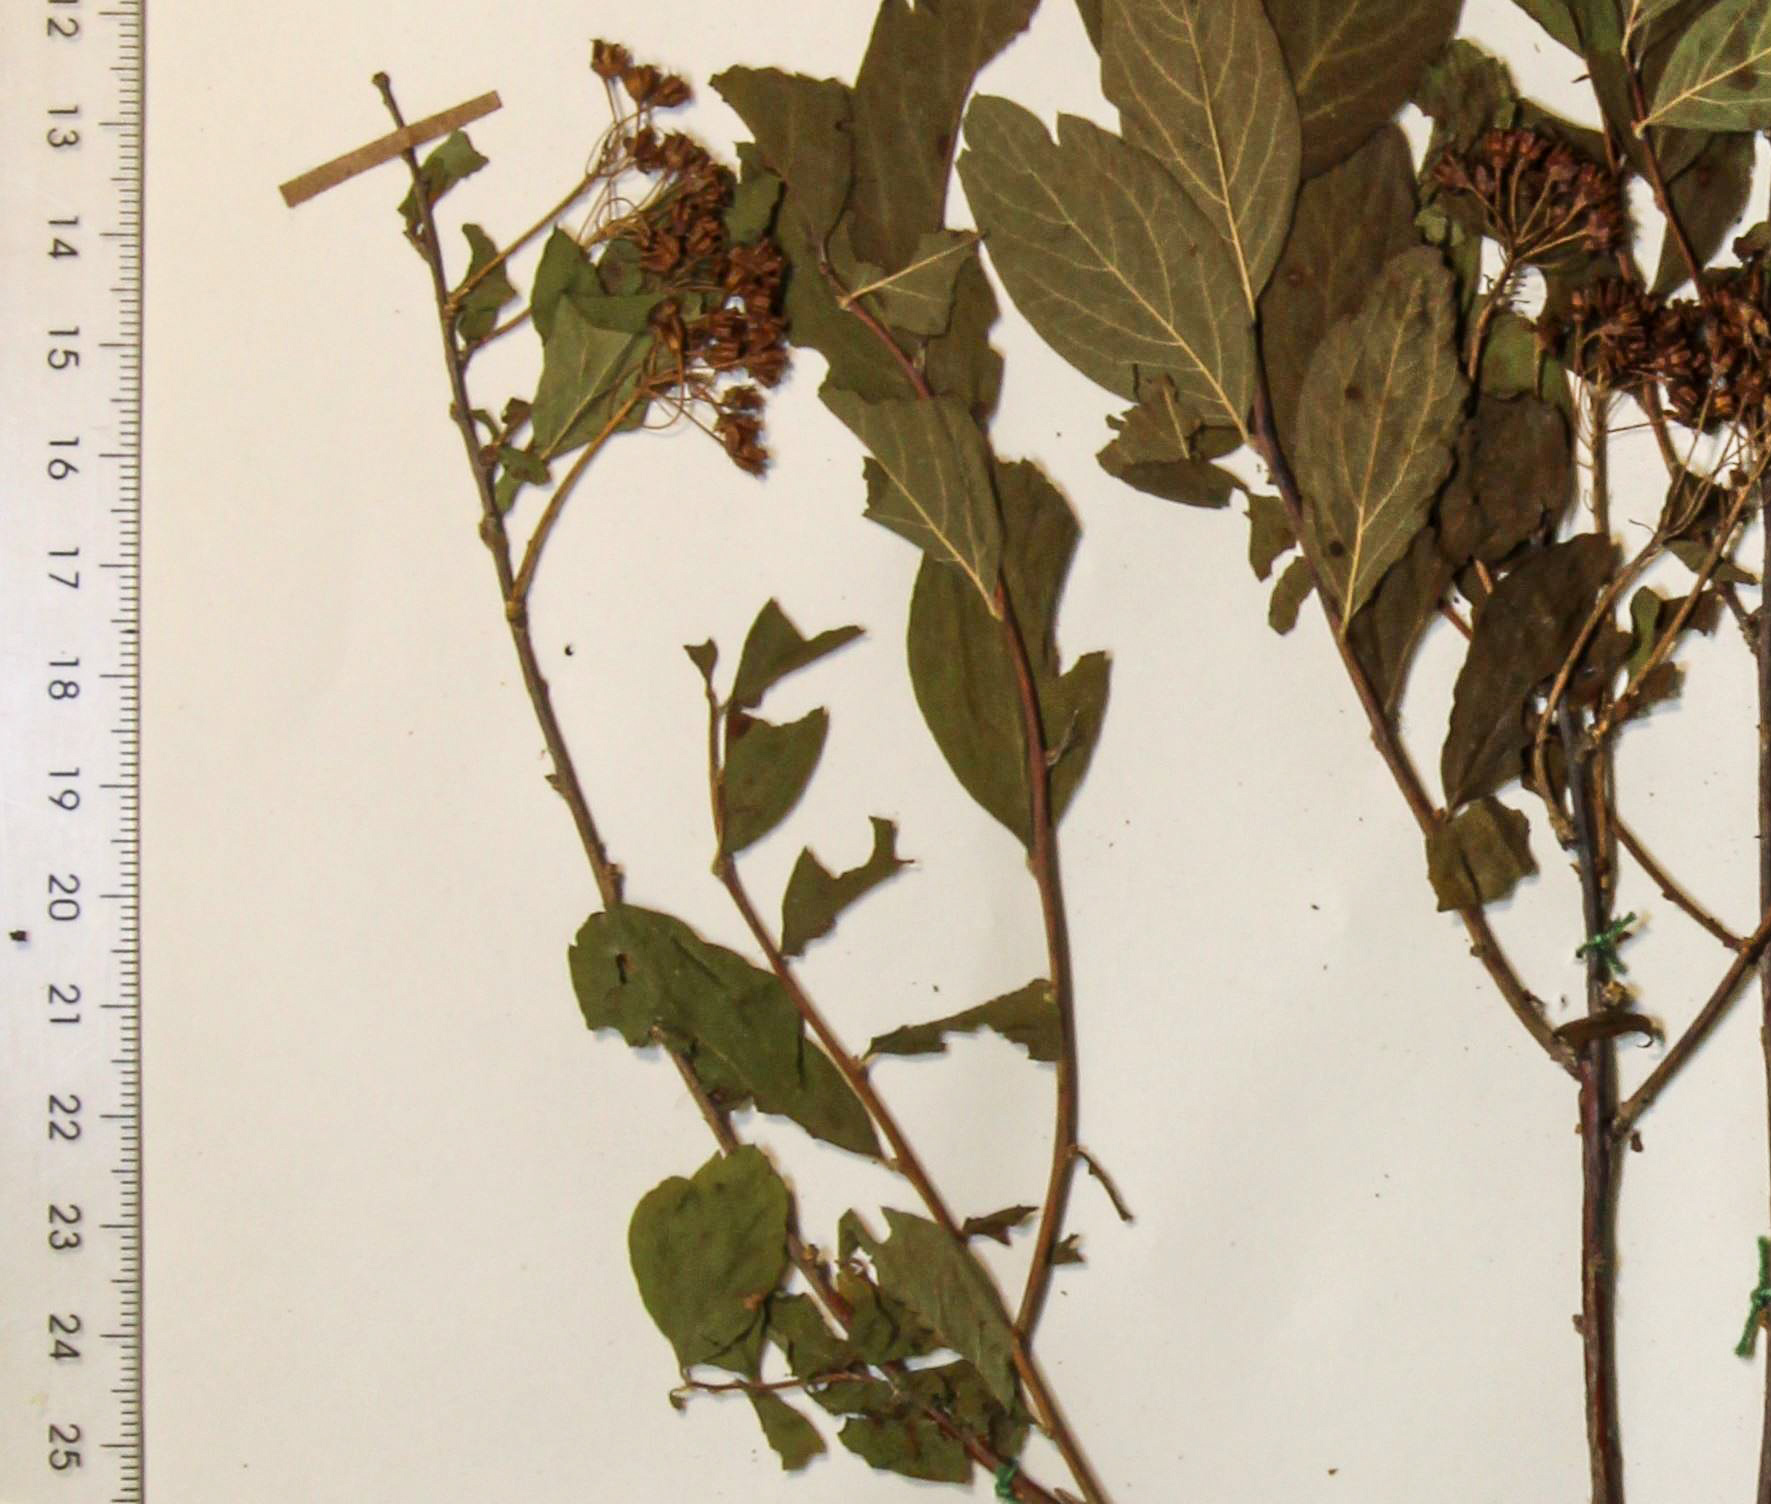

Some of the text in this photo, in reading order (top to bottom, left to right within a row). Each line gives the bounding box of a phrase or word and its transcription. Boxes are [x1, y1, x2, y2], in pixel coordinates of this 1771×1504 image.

[46, 104, 81, 151] 13
[47, 216, 79, 261] 14
[47, 326, 80, 371] 15
[46, 436, 79, 481] 16
[47, 546, 79, 590] 17
[47, 657, 80, 701] 18
[48, 767, 80, 812] 19
[47, 873, 80, 920] 20
[48, 984, 81, 1024] 21
[48, 1094, 81, 1141] 22
[48, 1204, 83, 1251] 23
[48, 1314, 83, 1361] 24
[48, 1424, 83, 1471] 25
